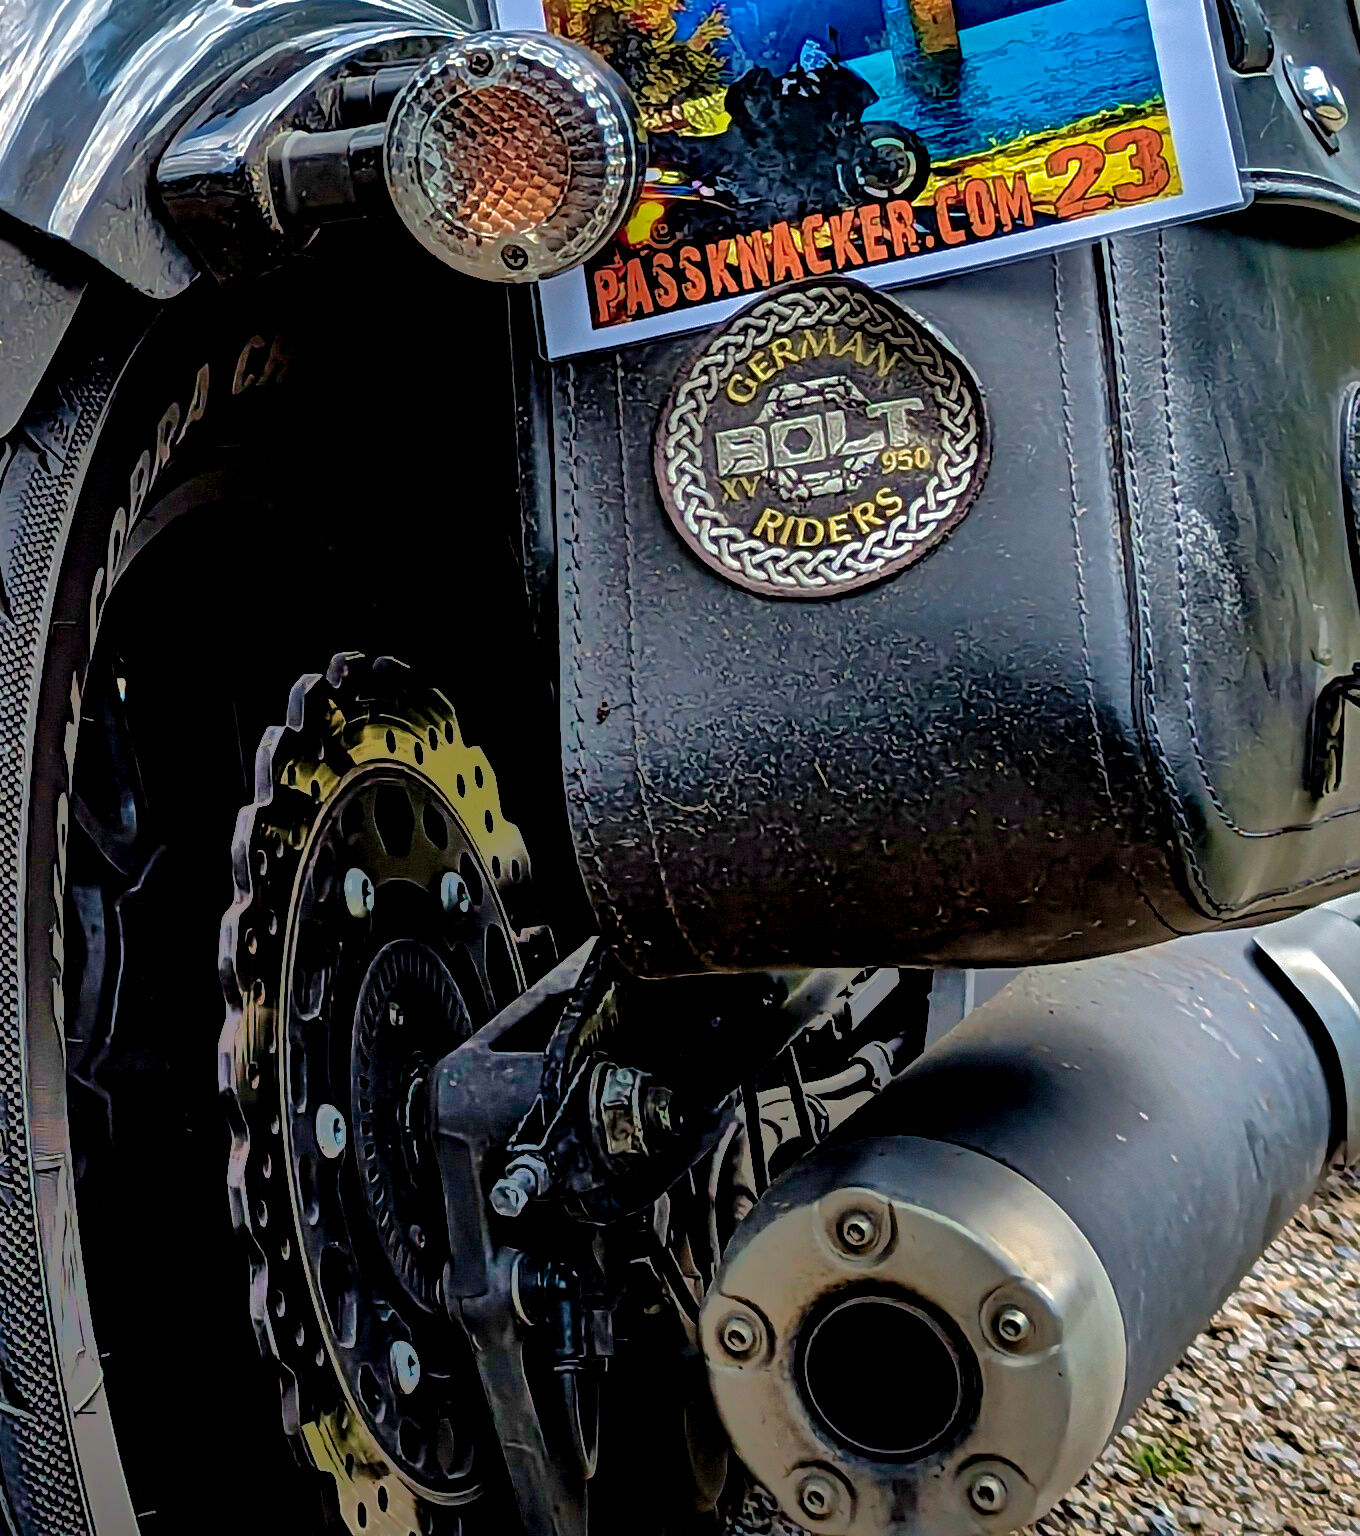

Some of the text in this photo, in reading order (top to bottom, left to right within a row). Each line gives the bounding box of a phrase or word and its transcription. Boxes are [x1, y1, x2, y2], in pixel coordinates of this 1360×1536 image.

[593, 127, 1174, 325] PASSKNACKER.COM 23
[726, 326, 902, 403] GERMAN
[715, 397, 925, 477] BOLT
[719, 447, 931, 504] XV 950
[751, 487, 903, 547] RIDERS
